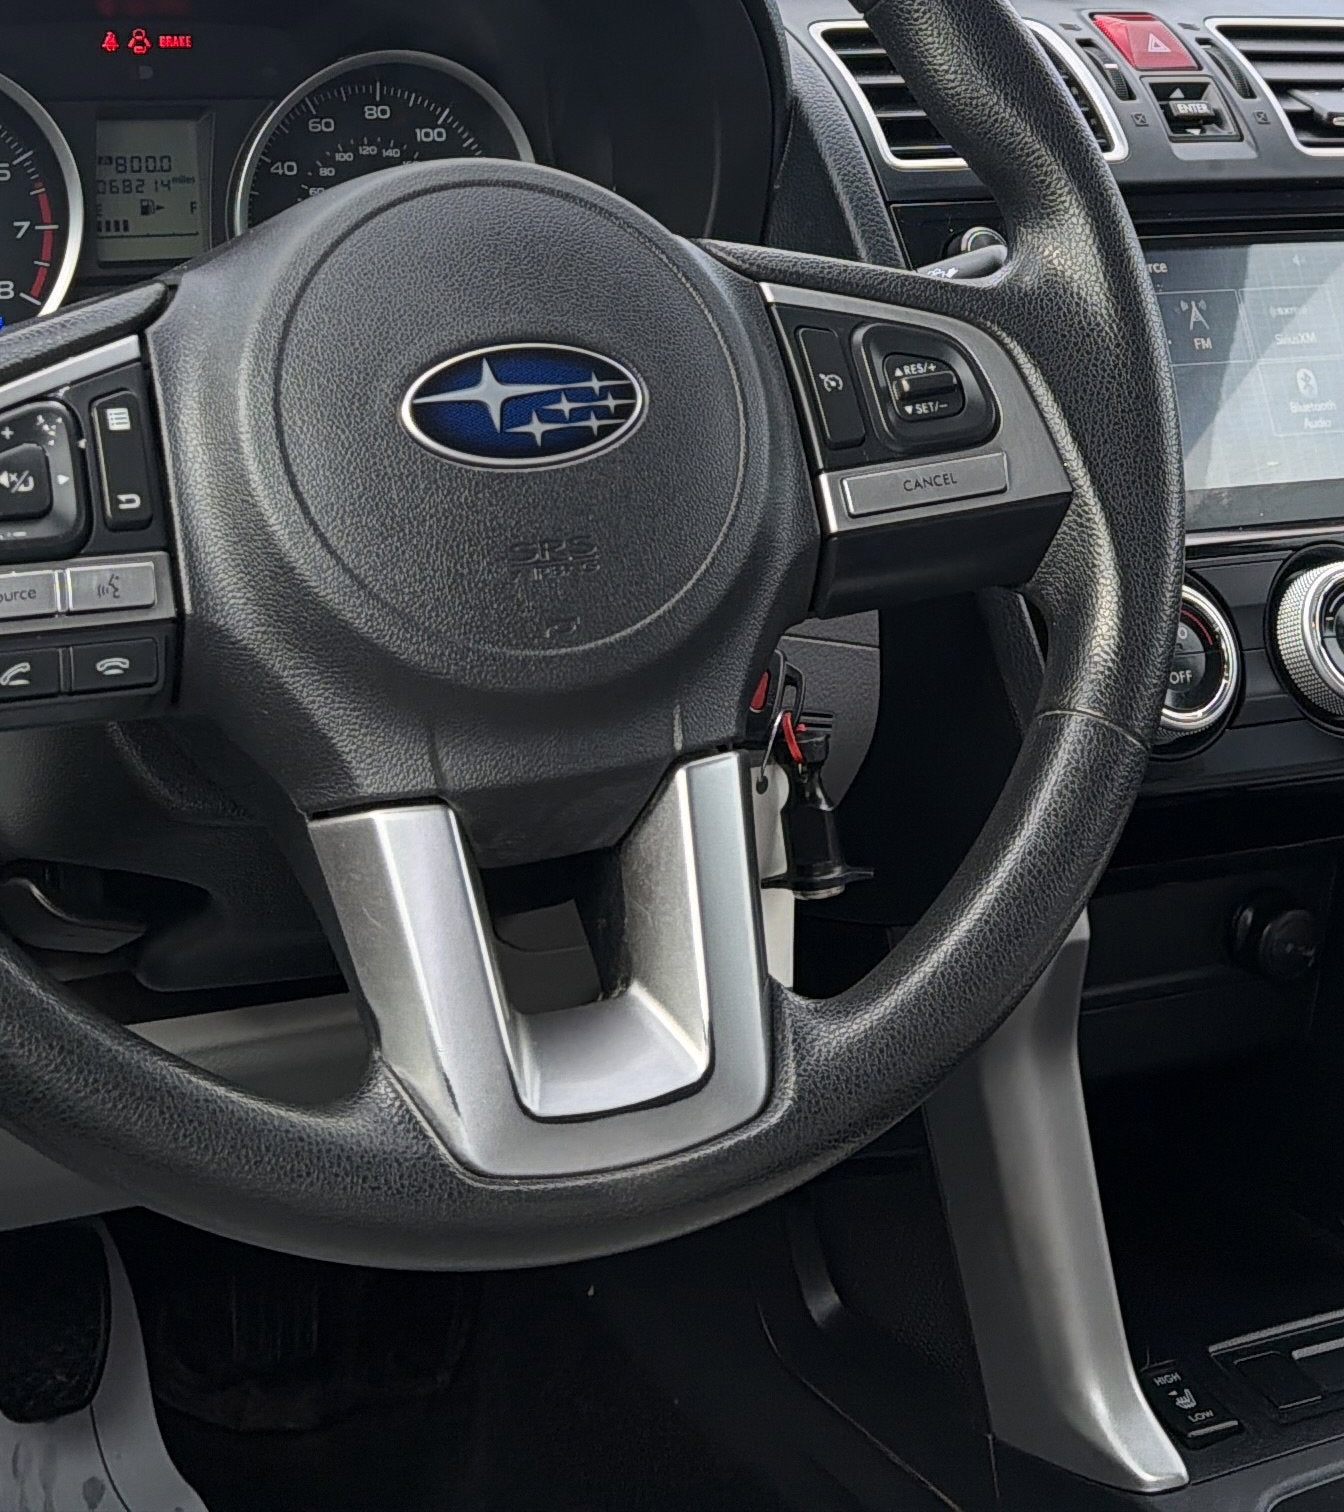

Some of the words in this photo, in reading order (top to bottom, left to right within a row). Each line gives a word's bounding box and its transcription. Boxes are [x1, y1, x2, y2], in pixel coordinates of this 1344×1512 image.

[159, 35, 192, 48] BRAKE
[364, 105, 390, 119] 80
[1176, 102, 1208, 114] ENTER
[308, 119, 334, 132] 60
[415, 127, 447, 142] 100
[335, 152, 354, 162] 100
[358, 146, 377, 155] 120
[382, 148, 401, 158] 140
[270, 161, 298, 176] 40
[319, 167, 336, 177] 80
[13, 221, 31, 238] 7
[1194, 338, 1213, 350] FM
[1274, 332, 1318, 345] SiriusXM
[1289, 399, 1337, 414] Bluetooth
[1304, 418, 1332, 429] Audio
[903, 473, 958, 492] CANCEL
[1169, 669, 1193, 686] OFF
[1154, 1371, 1183, 1387] HIGH
[1188, 1409, 1214, 1423] LOW
